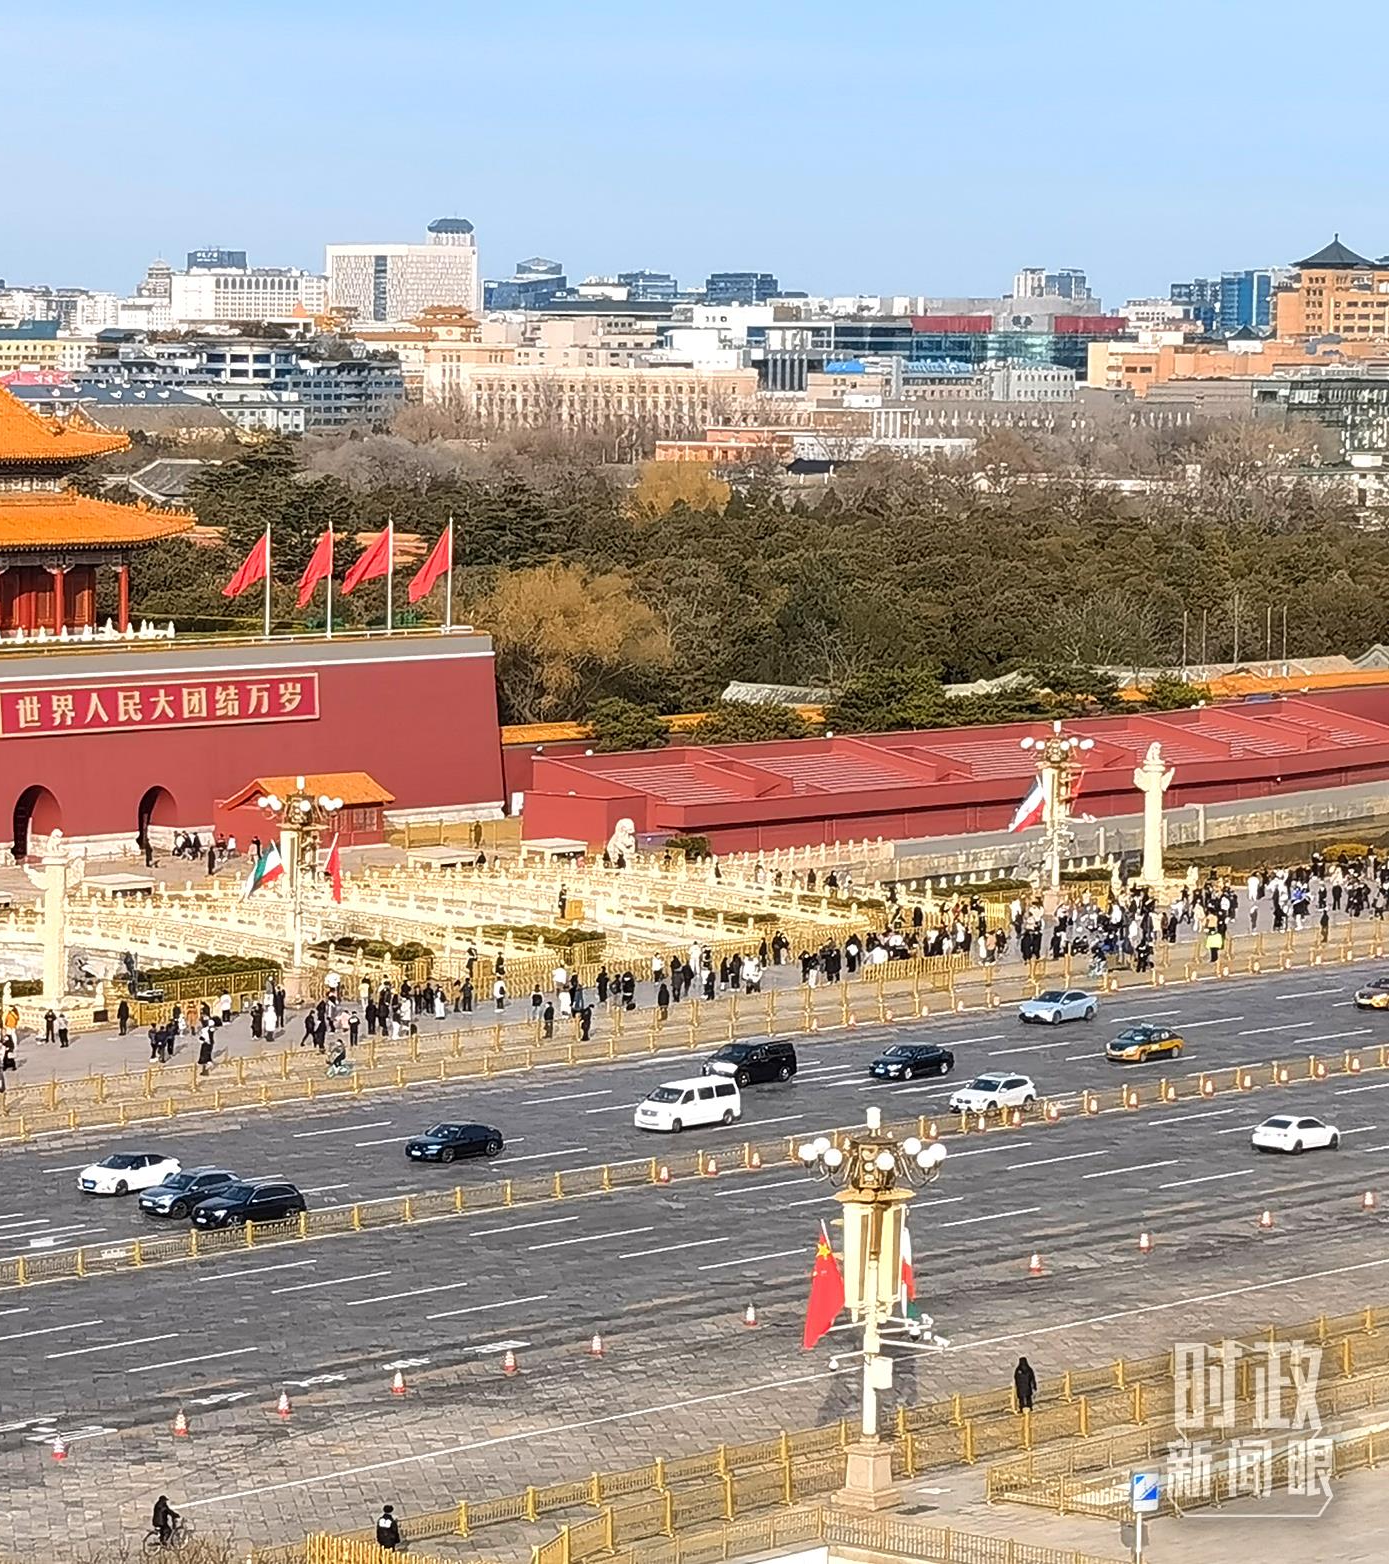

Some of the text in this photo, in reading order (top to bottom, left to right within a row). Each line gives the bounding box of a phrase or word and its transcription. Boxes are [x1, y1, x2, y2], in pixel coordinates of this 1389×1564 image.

[15, 683, 303, 729] 世界人民大团结万岁
